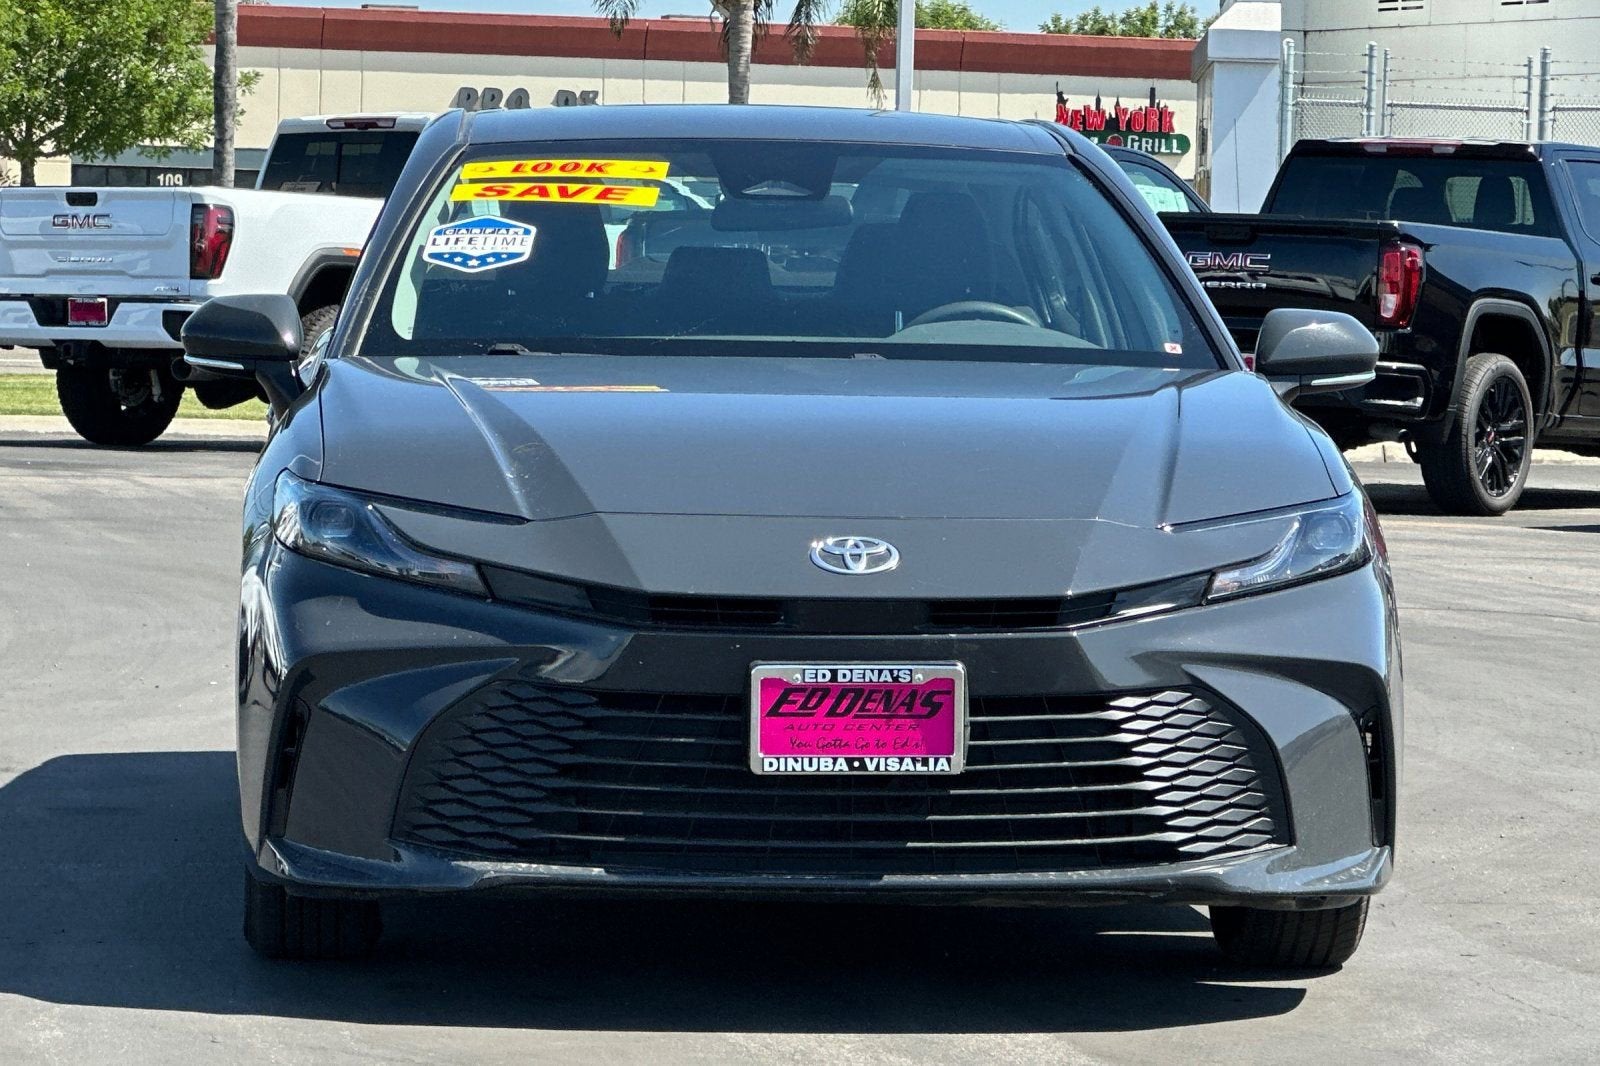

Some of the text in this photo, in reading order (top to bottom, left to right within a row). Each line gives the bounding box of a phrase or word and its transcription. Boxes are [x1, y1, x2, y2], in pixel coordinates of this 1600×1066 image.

[1056, 104, 1175, 133] NEW YORK
[1127, 135, 1182, 153] GRILL
[510, 162, 614, 174] LOOK
[157, 173, 183, 186] 109
[473, 185, 635, 201] SAVE
[52, 214, 112, 229] GMC
[431, 237, 529, 247] LIFETIME
[1184, 251, 1271, 272] GMC
[804, 669, 912, 683] ED DENA'S
[765, 687, 832, 718] ED
[784, 723, 921, 732] AUTO CENTER
[789, 736, 812, 750] You
[815, 736, 850, 752] Gotta
[854, 736, 871, 750] Go
[874, 738, 887, 750] to
[763, 757, 950, 772] DINUBA VISALIA
